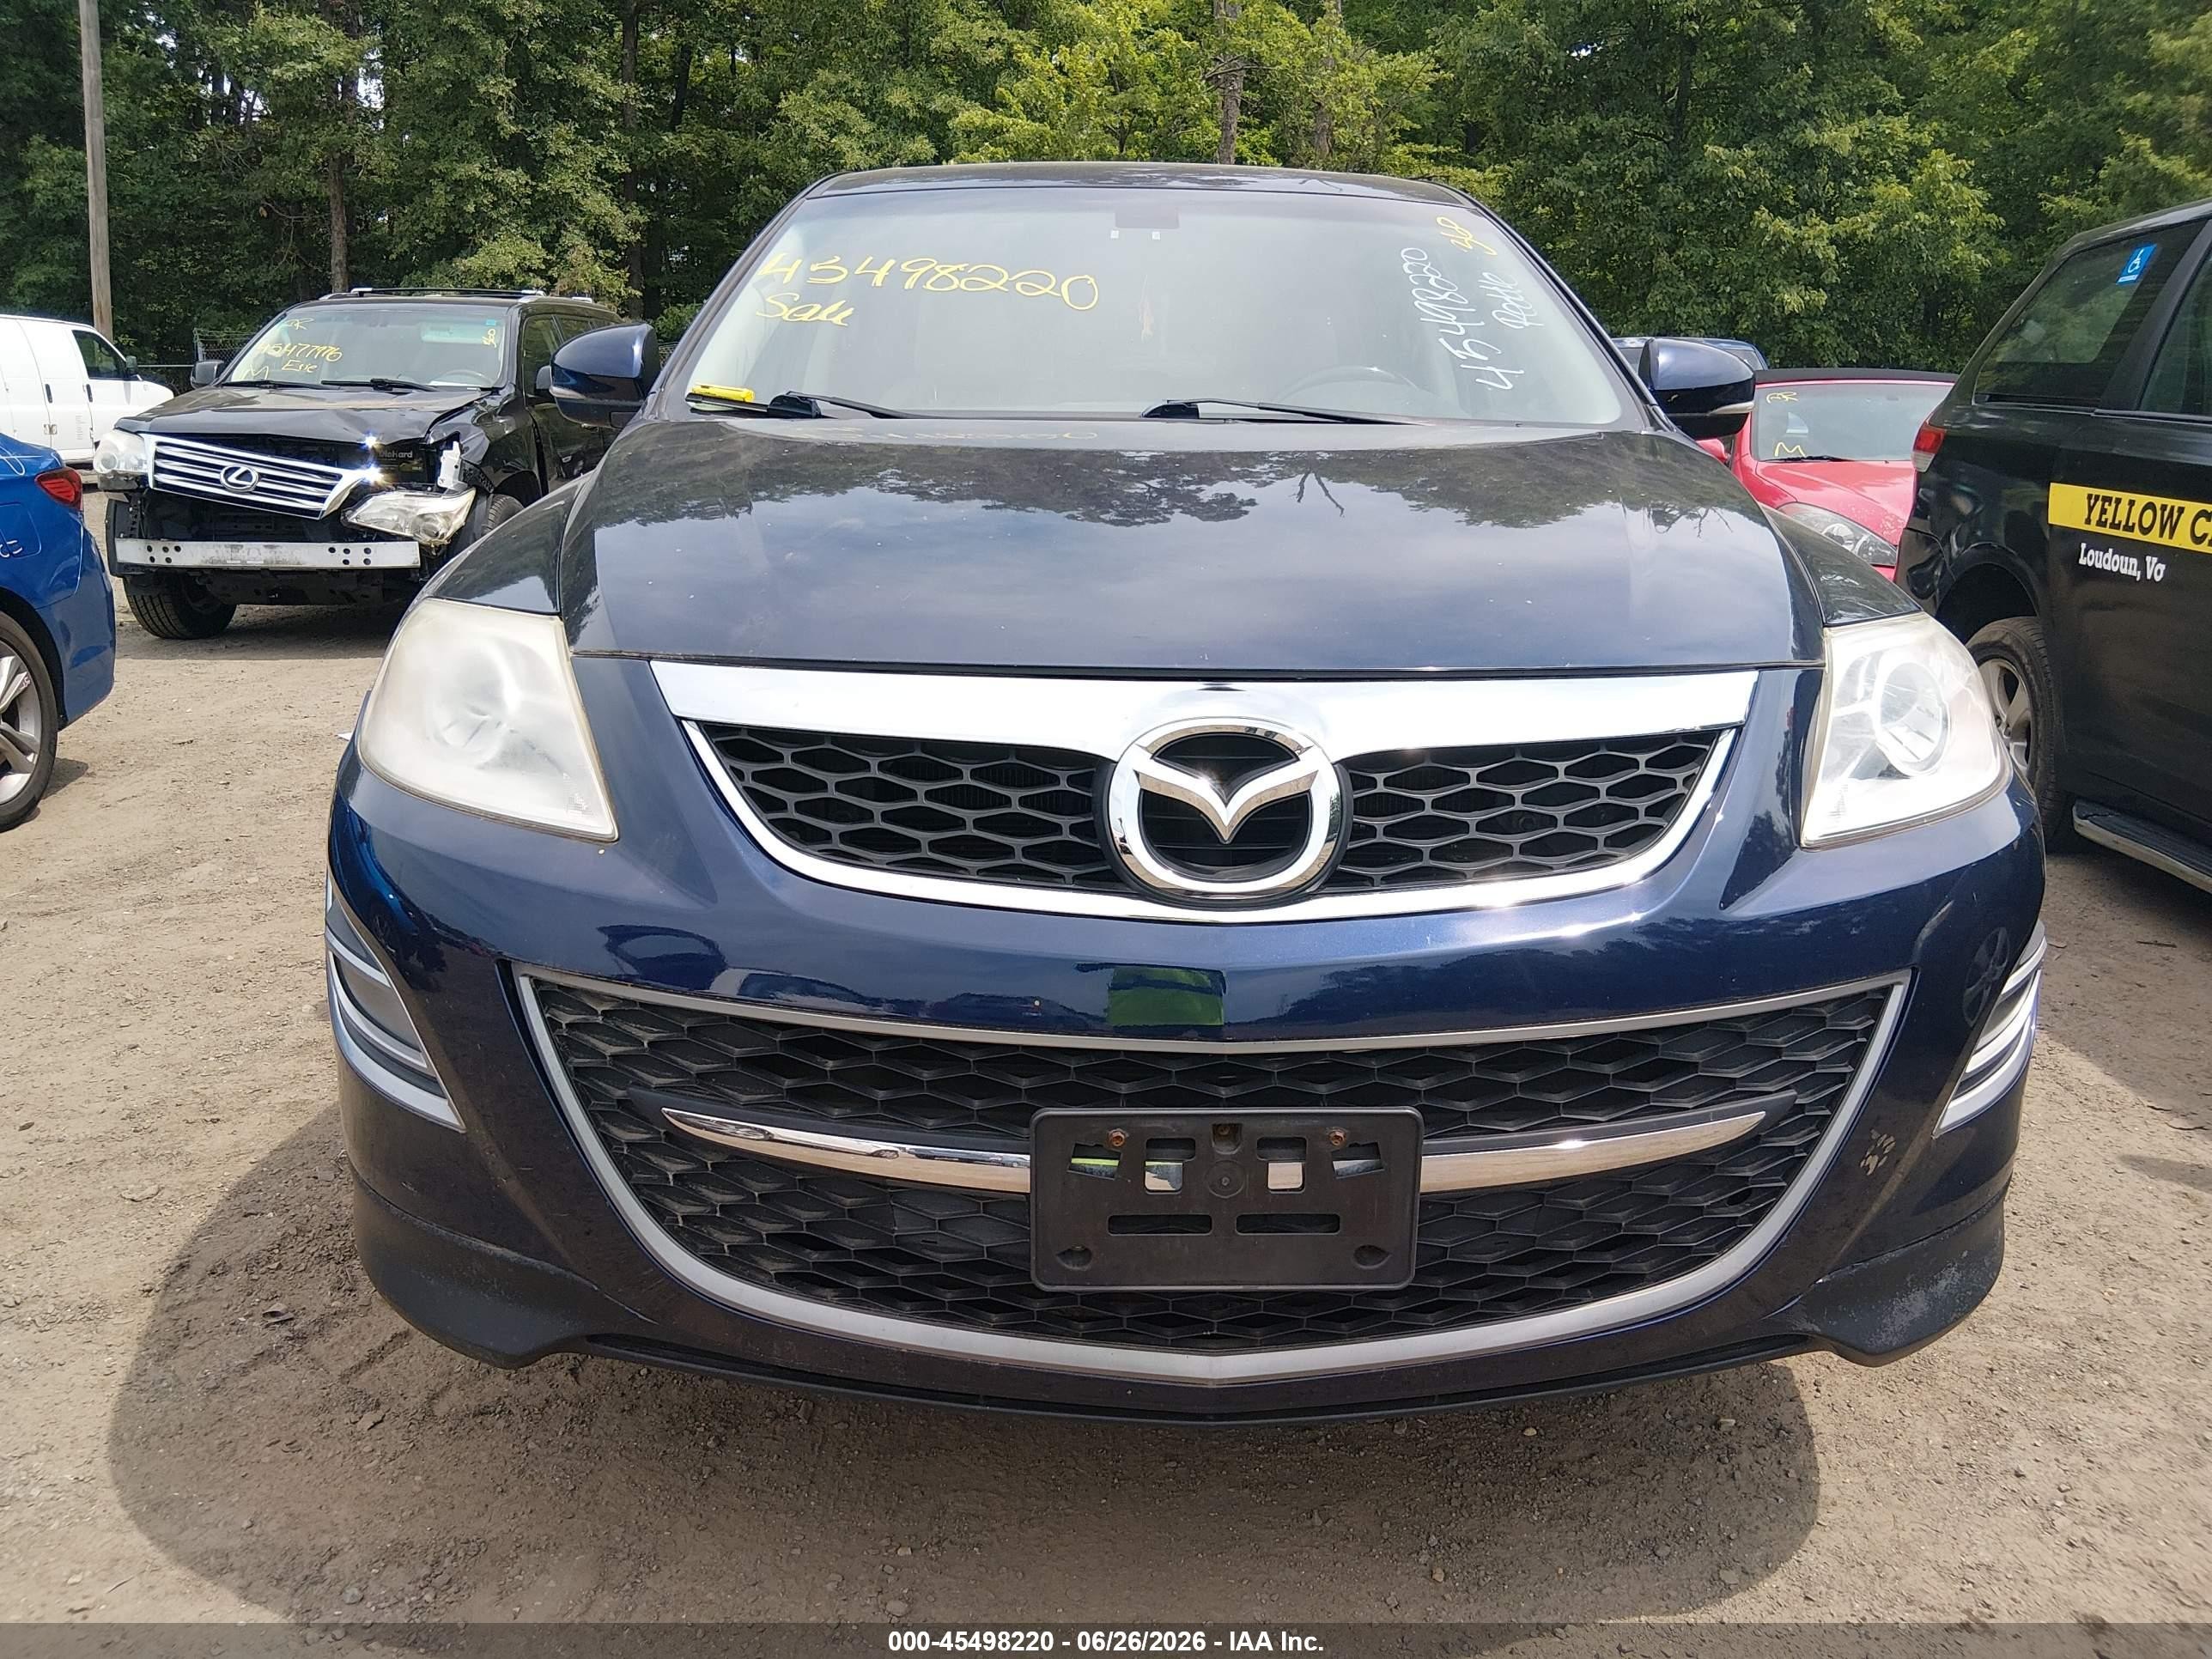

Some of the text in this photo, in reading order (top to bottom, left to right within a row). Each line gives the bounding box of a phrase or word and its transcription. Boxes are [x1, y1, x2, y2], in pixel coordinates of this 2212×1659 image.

[757, 252, 1099, 311] 45498220
[1401, 247, 1525, 391] 45498220
[2084, 493, 2212, 547] YELLOW C
[2078, 542, 2142, 581] Loudoun,
